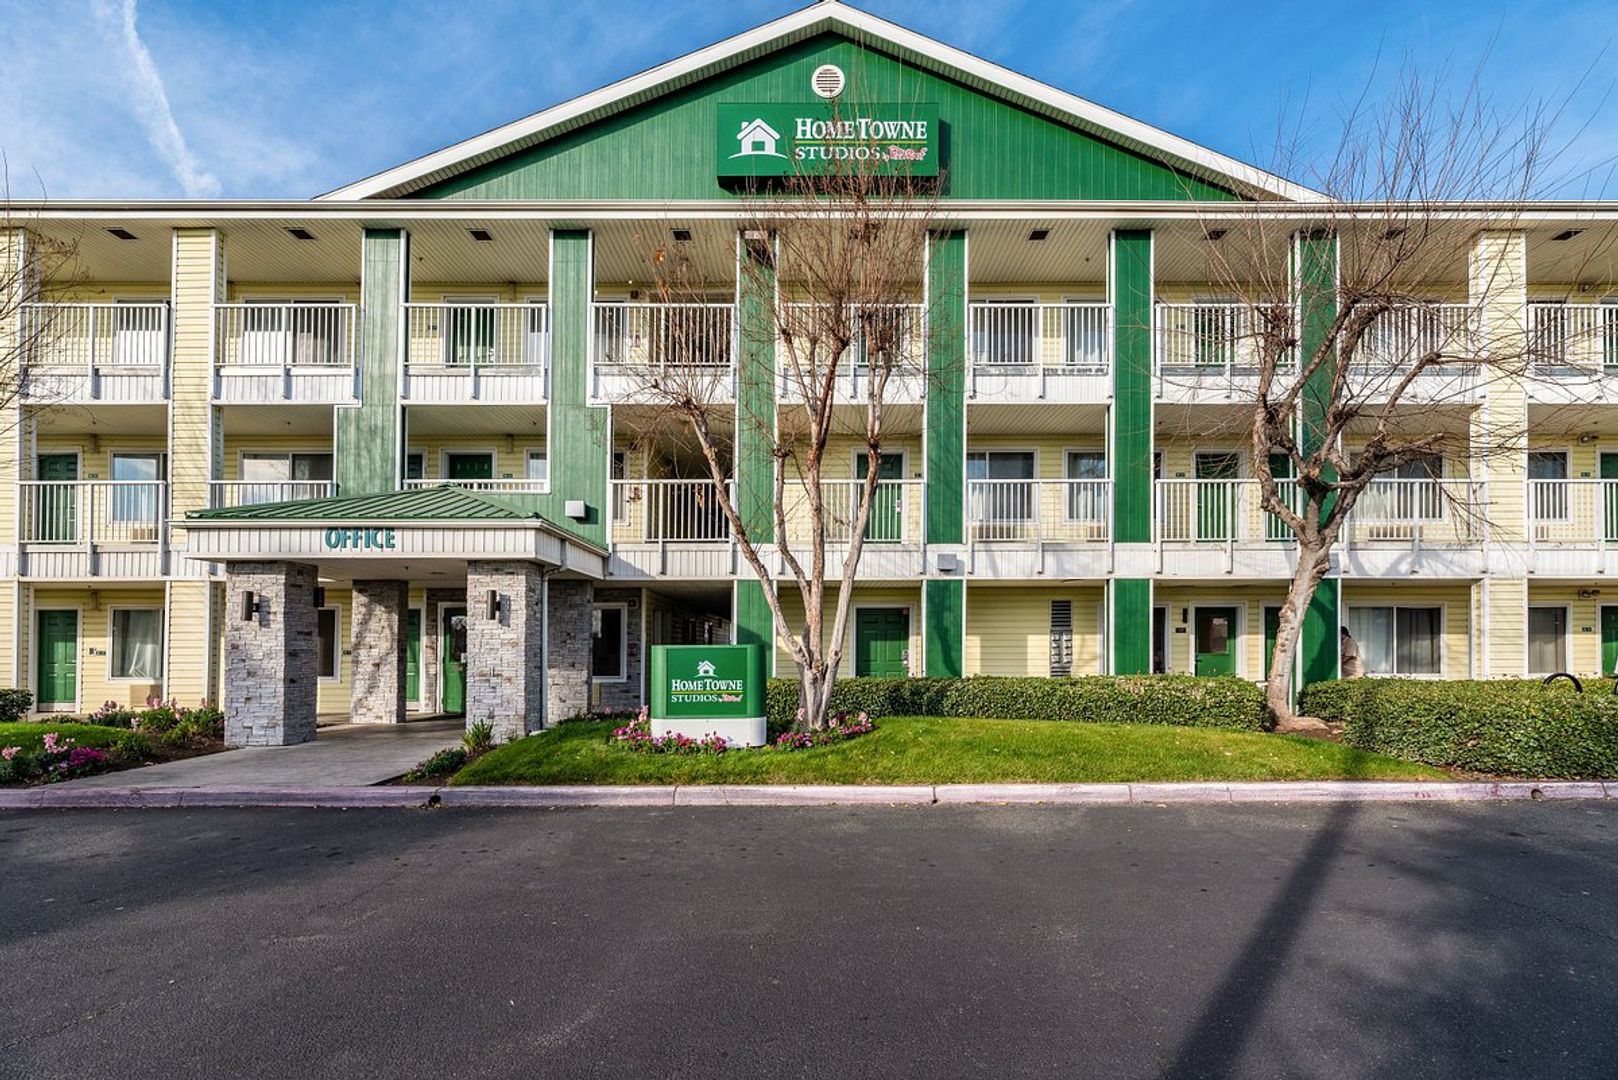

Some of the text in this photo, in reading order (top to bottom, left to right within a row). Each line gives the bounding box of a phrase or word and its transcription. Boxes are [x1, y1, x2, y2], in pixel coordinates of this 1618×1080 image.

[795, 146, 880, 160] STUDIOS
[325, 528, 396, 548] OFFICE
[671, 694, 718, 702] STUDIOS
